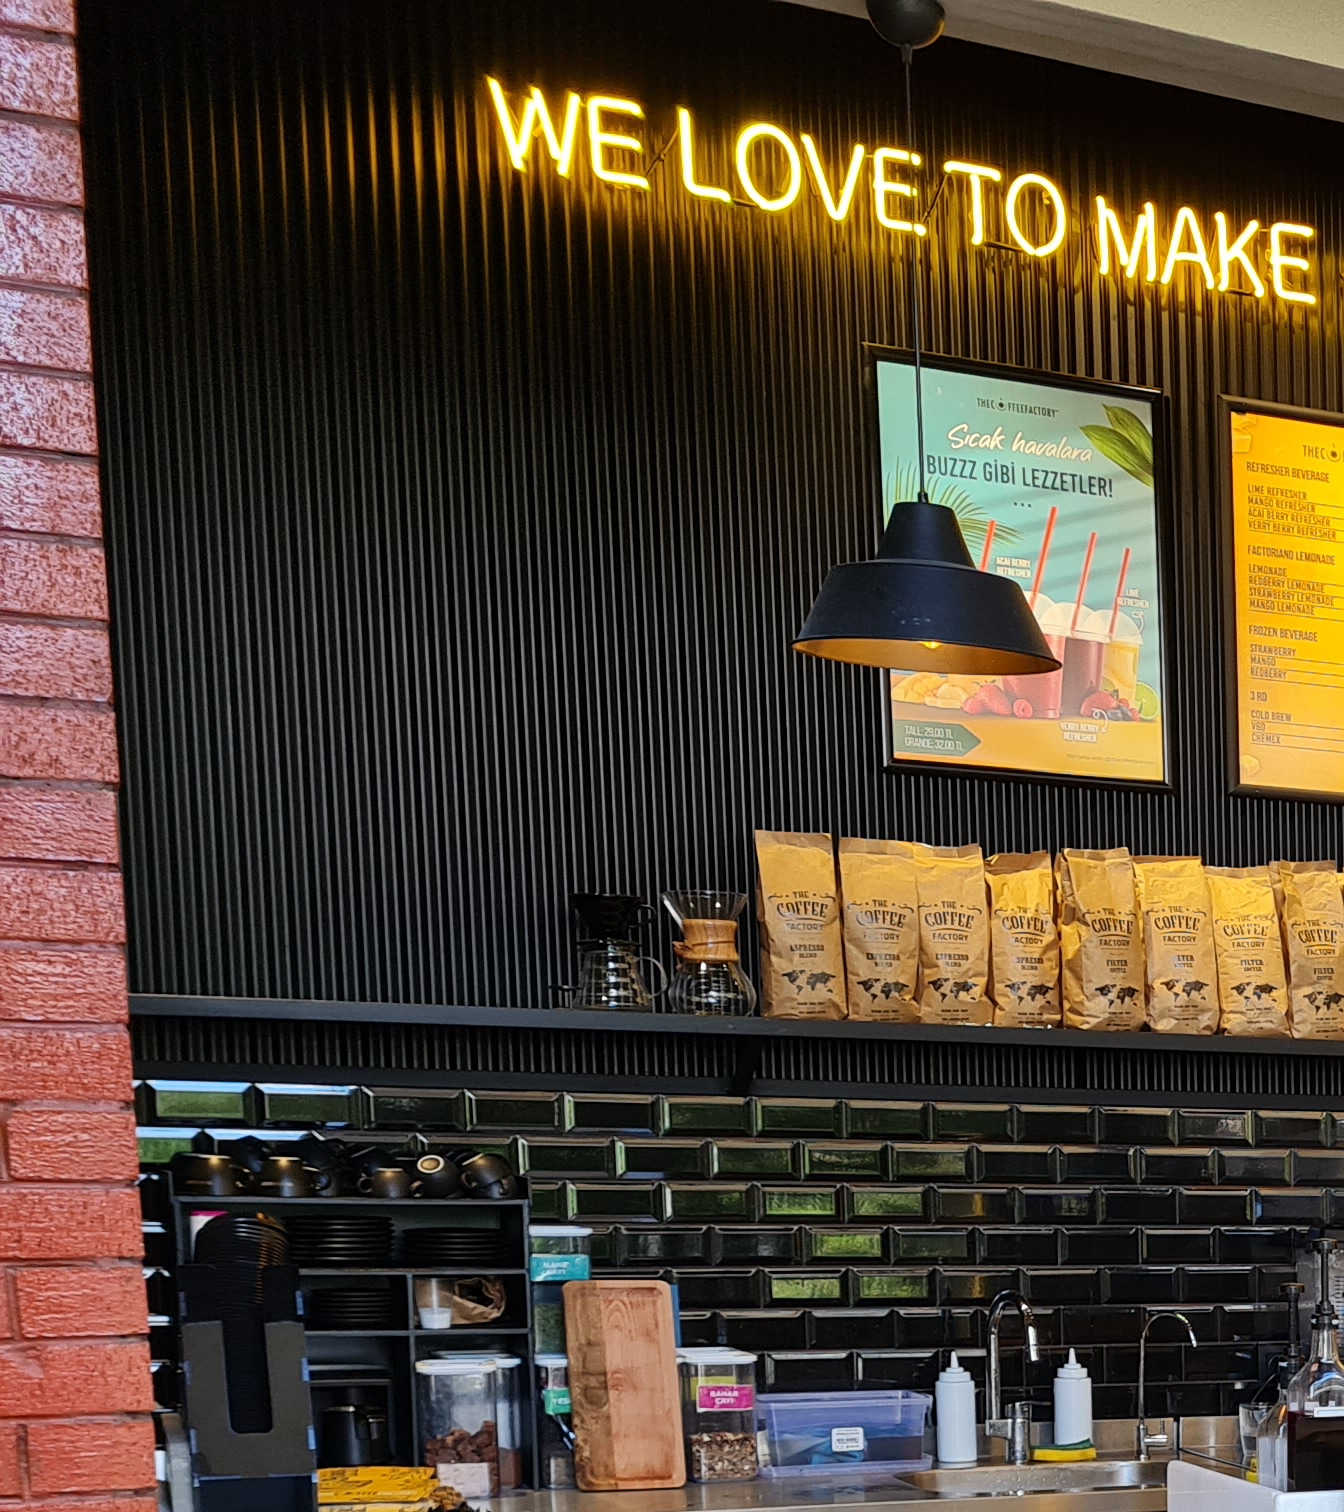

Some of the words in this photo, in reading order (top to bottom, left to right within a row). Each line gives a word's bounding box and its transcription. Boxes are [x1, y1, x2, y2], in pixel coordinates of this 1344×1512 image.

[487, 75, 648, 190] WE
[679, 105, 927, 237] LOVE
[944, 160, 1066, 258] TO
[1096, 194, 1316, 305] MAKE
[1011, 431, 1093, 462] havalara
[926, 454, 978, 481] BUZZZ
[983, 458, 1015, 485] GİBİ
[1022, 466, 1113, 498] LEZZETLER!
[1246, 461, 1290, 478] REFRESHER
[1291, 468, 1330, 483] BEVERAGE
[1248, 484, 1264, 495] LIME
[1266, 486, 1307, 500] REFRESHER
[1248, 496, 1274, 508] MANGO
[1276, 499, 1316, 513] REFRESHER
[1248, 508, 1264, 519] ACAI
[1266, 510, 1289, 522] BERRY
[1291, 513, 1331, 527] REFRESHER
[1248, 520, 1272, 531] VERRY
[1273, 523, 1295, 534] BERRY
[1297, 526, 1336, 540] REFRESHER
[1295, 551, 1335, 566] LEMONADE
[1248, 564, 1287, 577] LEMONADE
[1248, 575, 1285, 588] REDBERRY
[1287, 579, 1324, 593] LEMONADE
[1248, 588, 1295, 602] STRAWBERRY
[1296, 592, 1334, 607] LEMONADE
[1249, 598, 1275, 611] MANGO
[1277, 601, 1315, 615] LEMONADE
[1249, 625, 1278, 639] FROZEN
[1279, 628, 1318, 642] BEVERAGE
[1250, 644, 1296, 657] STRAWBERRY
[1251, 656, 1276, 667] MANGO
[1251, 667, 1287, 680] REDBERRY
[1251, 709, 1269, 720] COLD
[1271, 711, 1291, 723] BREW
[1251, 733, 1281, 745] CHEMEX
[777, 901, 828, 919] COFFEE
[856, 910, 907, 929] COFFEE
[924, 912, 975, 930] COFFEE
[1091, 918, 1134, 935] COFFEE
[1154, 915, 1200, 932] COFFEE
[1298, 929, 1338, 944] COFFEE
